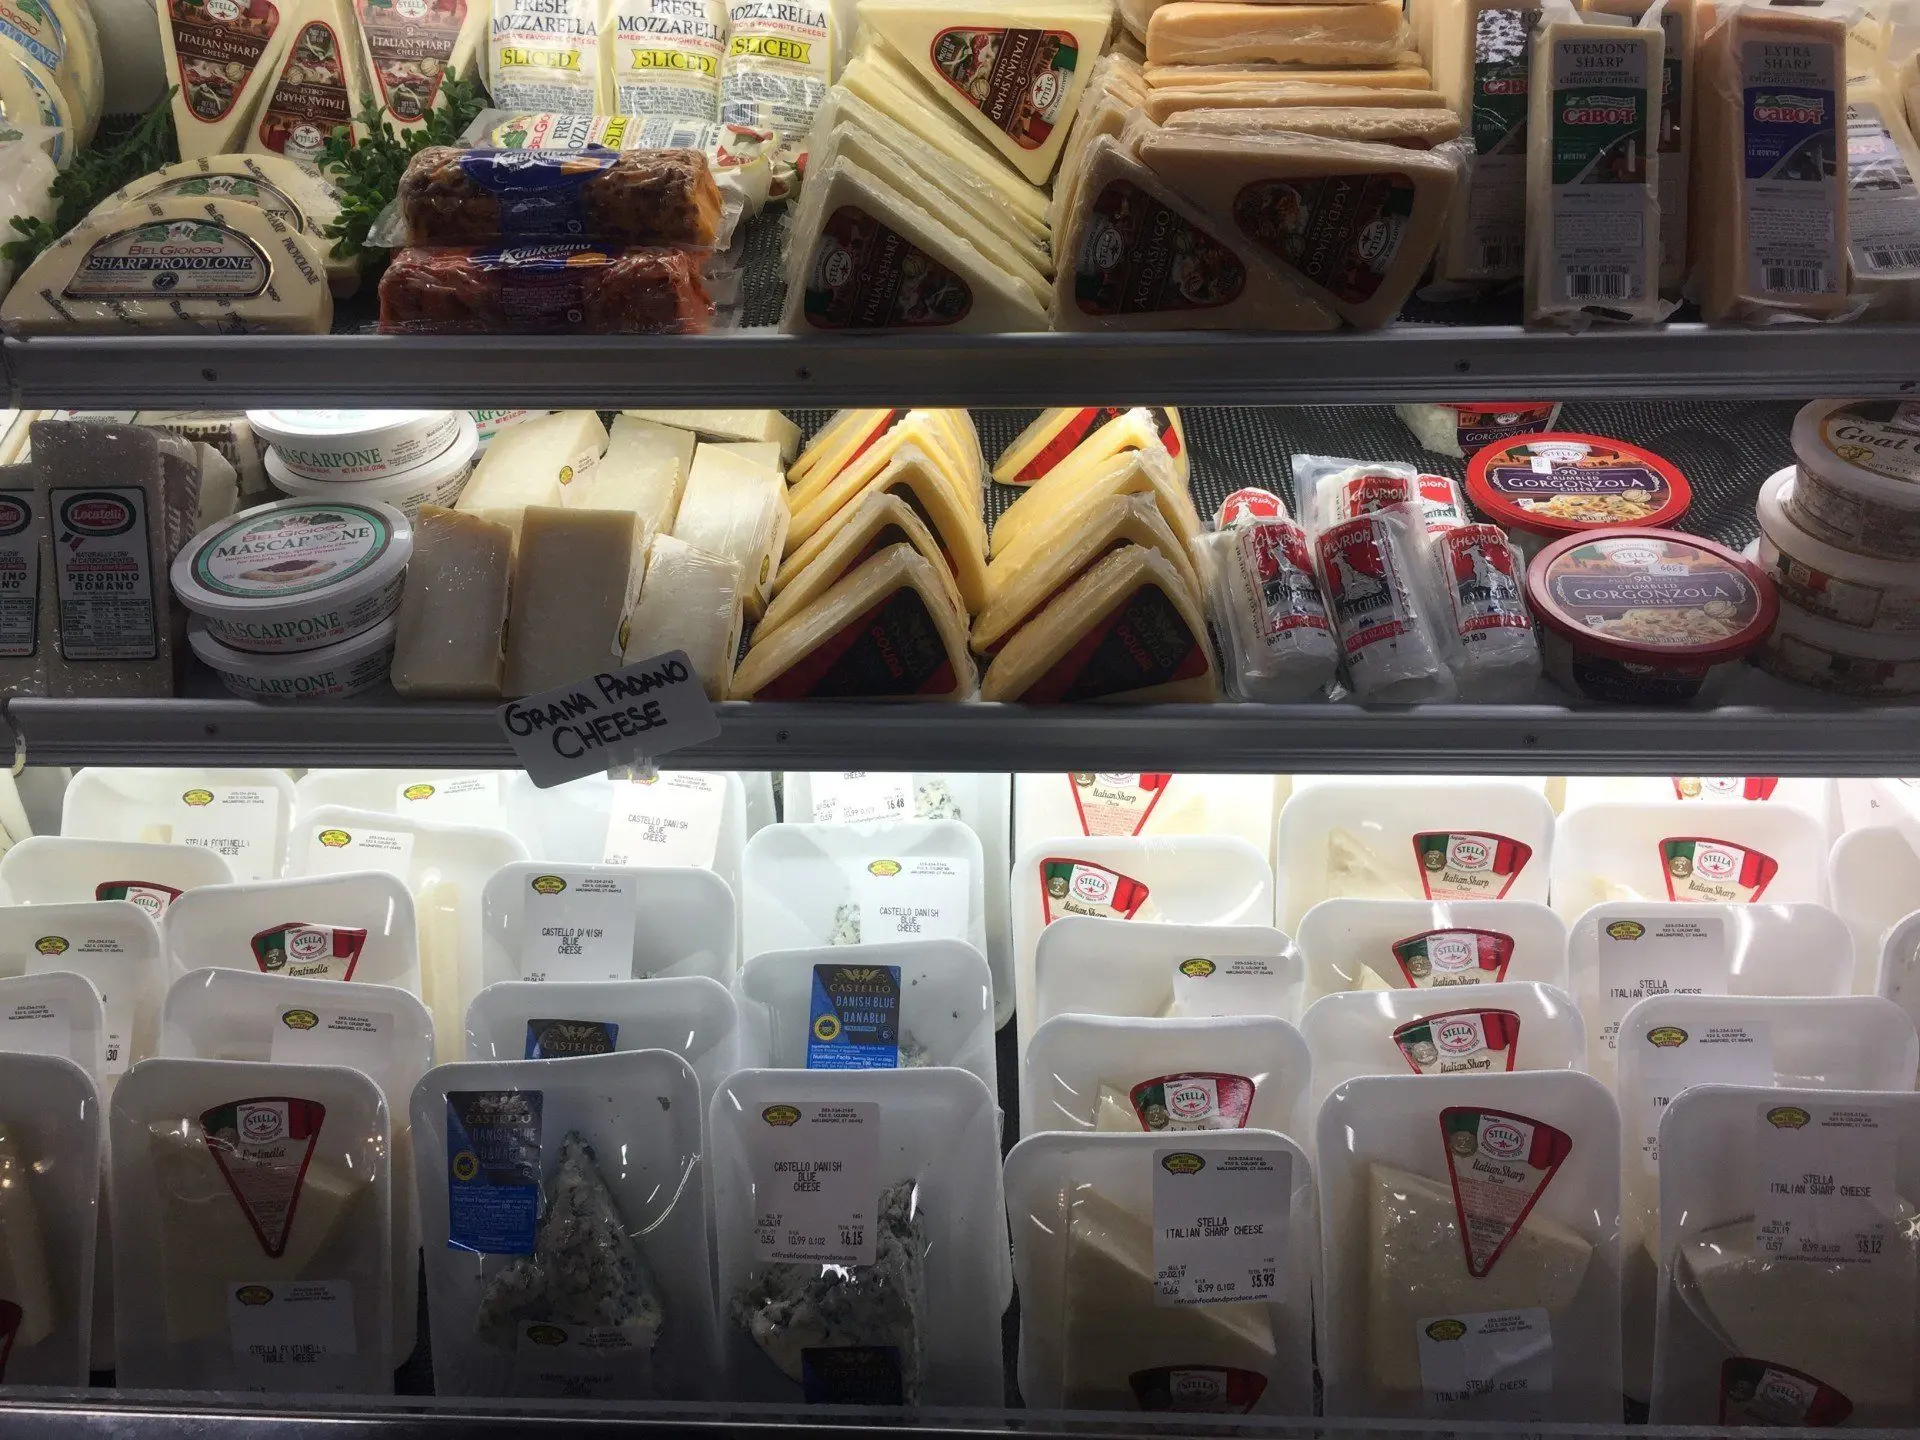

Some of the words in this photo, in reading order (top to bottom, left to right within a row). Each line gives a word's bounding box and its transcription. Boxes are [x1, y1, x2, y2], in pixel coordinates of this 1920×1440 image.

[493, 15, 597, 36] MOZZARELLA
[617, 16, 727, 46] MOZZARELLA
[179, 32, 221, 50] ITALIAN
[222, 40, 259, 57] SHARP
[372, 35, 415, 48] ITALIAN
[416, 38, 451, 51] SHARP
[736, 39, 803, 60] SLICED
[1560, 43, 1640, 55] VERMONT
[203, 48, 229, 60] CHEESE
[396, 49, 424, 57] CHEESE
[1005, 34, 1029, 80] ITALIAN
[1764, 45, 1812, 57] EXTRA
[504, 50, 571, 67] SLICED
[641, 51, 711, 73] SLICED
[1575, 56, 1625, 68] SHARP
[1764, 58, 1813, 70] SHARP
[993, 57, 1008, 87] CHEESE
[1037, 76, 1054, 107] STELLA
[990, 81, 1011, 120] SHARP
[552, 115, 575, 140] FRES
[128, 245, 224, 256] BELGIOIOSO
[89, 257, 149, 270] SHARP
[151, 257, 252, 271] PROVOLONE
[282, 236, 319, 286] PROVOLONE
[160, 276, 170, 287] 7
[1836, 425, 1905, 451] Goat
[277, 447, 383, 470] MASCARPONE
[1507, 477, 1646, 490] GORGONZOLA
[1351, 487, 1408, 502] CHEVRION
[72, 506, 122, 522] Locatelli
[1614, 550, 1656, 561] STELLA
[68, 573, 140, 581] PECORINO
[1633, 575, 1651, 583] 90
[75, 581, 134, 590] ROMANO
[1574, 585, 1730, 600] GORGONZOLA
[1633, 597, 1677, 605] CHEESE
[212, 611, 341, 640] MASCARPONE
[504, 692, 599, 737] GRANA
[594, 660, 689, 704] PADANO
[552, 700, 668, 759] CHEESE
[1093, 787, 1117, 800] Italian
[1116, 790, 1137, 804] Sharp
[628, 814, 660, 827] CASTELLO
[663, 818, 689, 831] DANISH
[647, 826, 665, 834] BLUE
[642, 833, 668, 844] CHEESE
[1457, 845, 1486, 857] STELLA
[1703, 853, 1732, 867] STELLA
[1079, 876, 1107, 891] STELLA
[1441, 871, 1467, 884] Italian
[1467, 874, 1490, 888] Sharp
[1688, 879, 1713, 894] Italian
[1712, 884, 1737, 900] Sharp
[879, 906, 912, 917] CASTELLO
[914, 908, 939, 918] DANISH
[1063, 901, 1089, 916] Italian
[900, 916, 918, 925] BLUE
[541, 926, 575, 938] CASTELLO
[896, 923, 921, 934] CHEESE
[295, 936, 324, 947] STELLA
[562, 936, 579, 946] BLUE
[557, 945, 583, 955] CHEESE
[1437, 944, 1468, 955] STELLA
[288, 965, 328, 977] Fontinella
[1432, 975, 1458, 987] Italian
[1639, 980, 1668, 989] STELLA
[828, 983, 891, 993] CASTELLO
[1610, 988, 1644, 998] ITALIAN
[836, 996, 871, 1007] DANISH
[873, 996, 895, 1009] BLUE
[843, 1012, 886, 1024] DANABLU
[1442, 1027, 1472, 1039] STELLA
[543, 1039, 605, 1053] CASTELLO
[1440, 1060, 1468, 1073] Italian
[1467, 1058, 1492, 1071] Sharp
[1175, 1089, 1207, 1104] STELLA
[247, 1114, 278, 1126] STELLA
[1486, 1127, 1521, 1145] STELLA
[774, 1161, 811, 1173] CASTELLO
[813, 1161, 842, 1173] DANISH
[1471, 1158, 1502, 1176] Italian
[1500, 1163, 1527, 1183] Sharp
[798, 1171, 817, 1182] BLUE
[1803, 1174, 1834, 1185] STELLA
[793, 1181, 822, 1192] CHEESE
[1770, 1183, 1806, 1194] ITALIAN
[1810, 1184, 1836, 1196] SHARP
[1840, 1185, 1872, 1197] CHEESE
[1197, 1217, 1228, 1228] STELLA
[1166, 1227, 1200, 1239] ITALIAN
[1204, 1226, 1230, 1237] SHARP
[1233, 1224, 1265, 1236] CHEESE
[1197, 1284, 1214, 1293] 8.99
[1251, 1273, 1275, 1288] $5.93
[1181, 1380, 1214, 1392] STELLA
[1499, 1378, 1528, 1391] CHEESE
